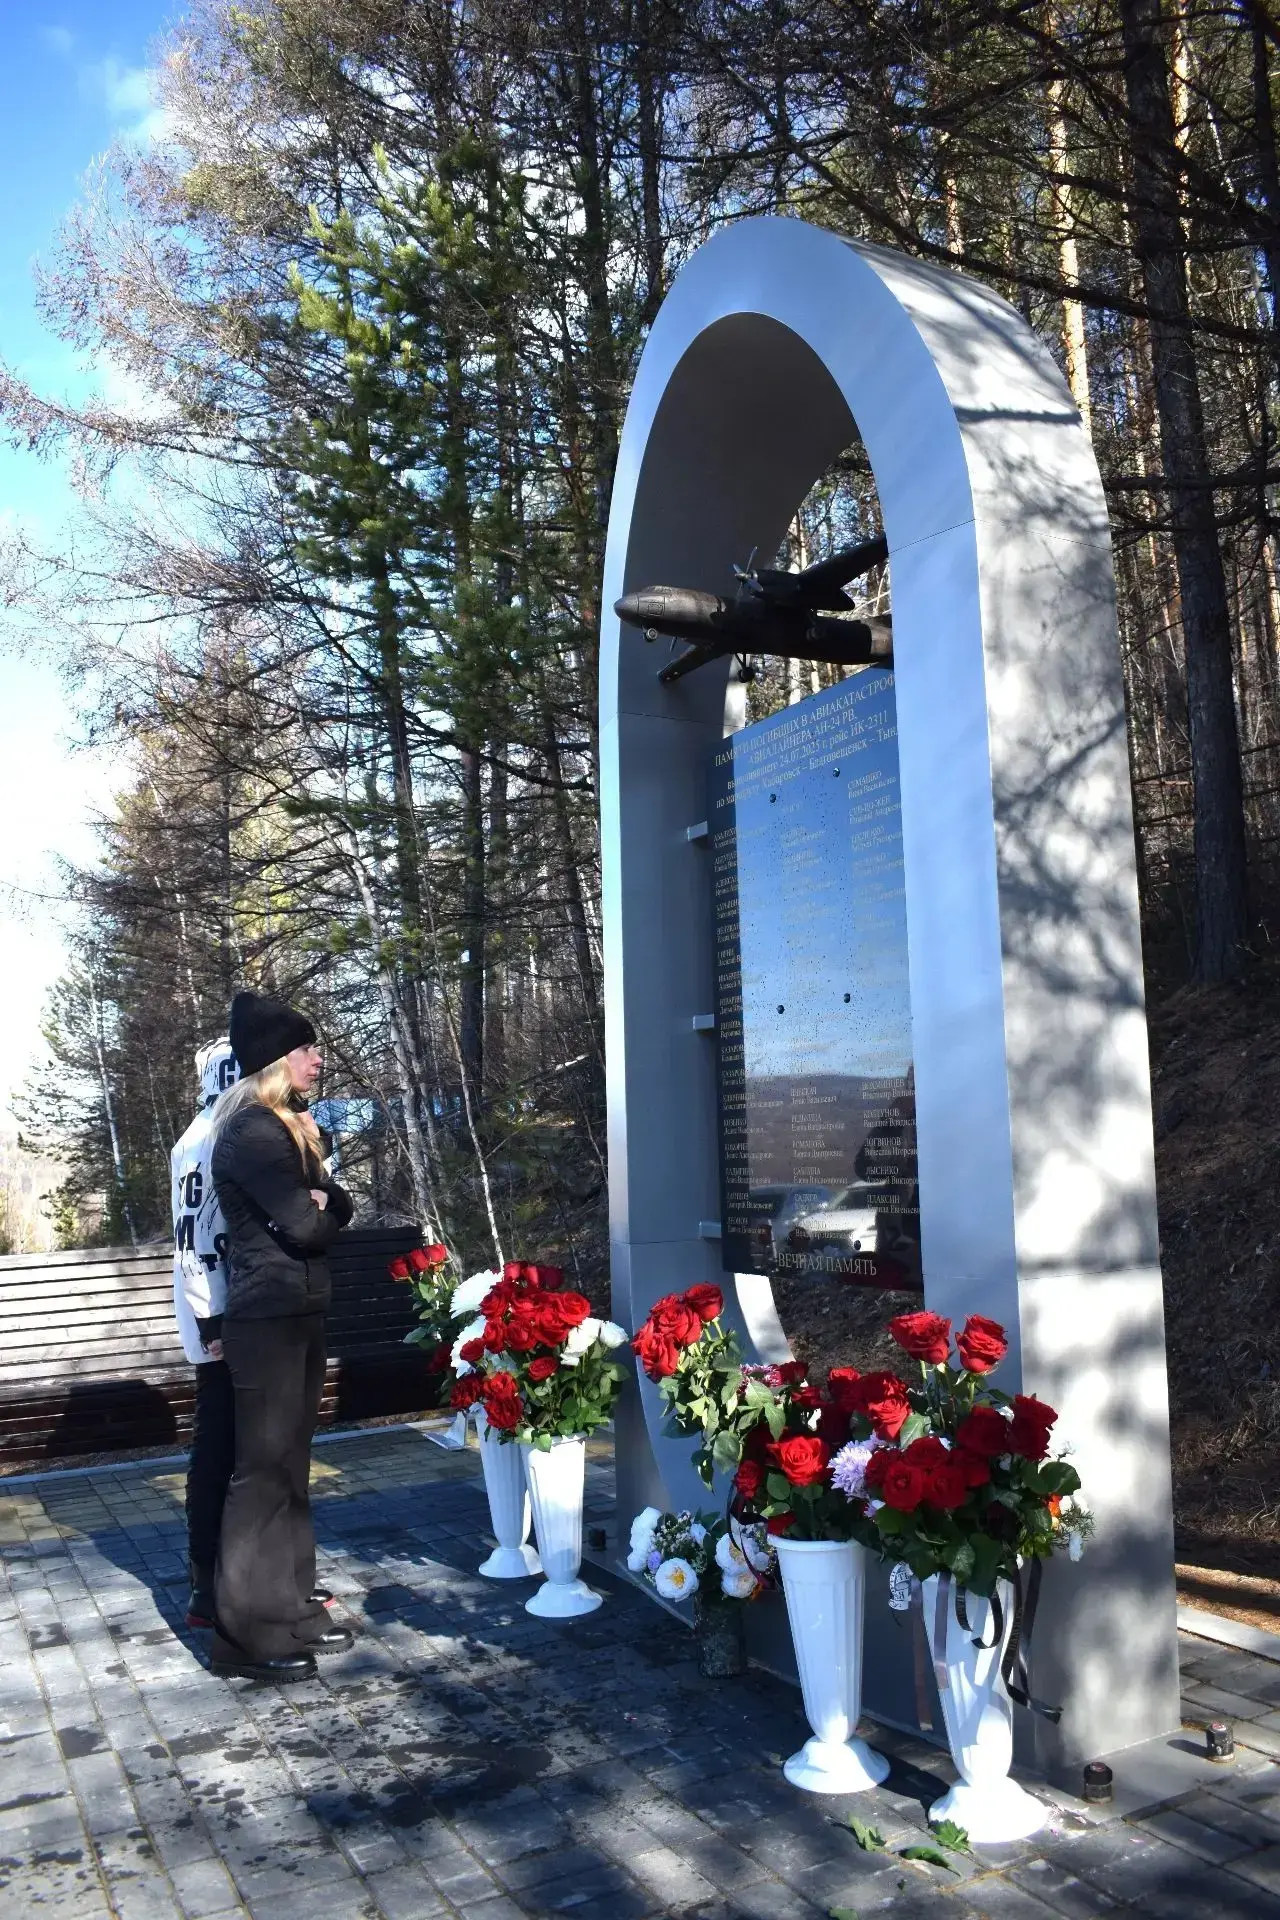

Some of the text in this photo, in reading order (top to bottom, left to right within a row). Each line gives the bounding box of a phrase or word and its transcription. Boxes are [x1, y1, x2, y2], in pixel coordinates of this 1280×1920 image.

[715, 673, 895, 767] ПАМЯТИ ПОГИБШИХ В АВИАКАТАСТРОФ
[749, 729, 812, 764] АВИАЛАЙНЕРА
[814, 715, 840, 736] АН-24
[850, 709, 888, 737] ИК-2311
[716, 798, 725, 809] по
[762, 766, 801, 788] Хабаровск
[809, 739, 868, 770] Благовещенск
[876, 726, 898, 742] Тын
[778, 1252, 877, 1276] ВЕЧНАЯ ПАМЯТЬ
